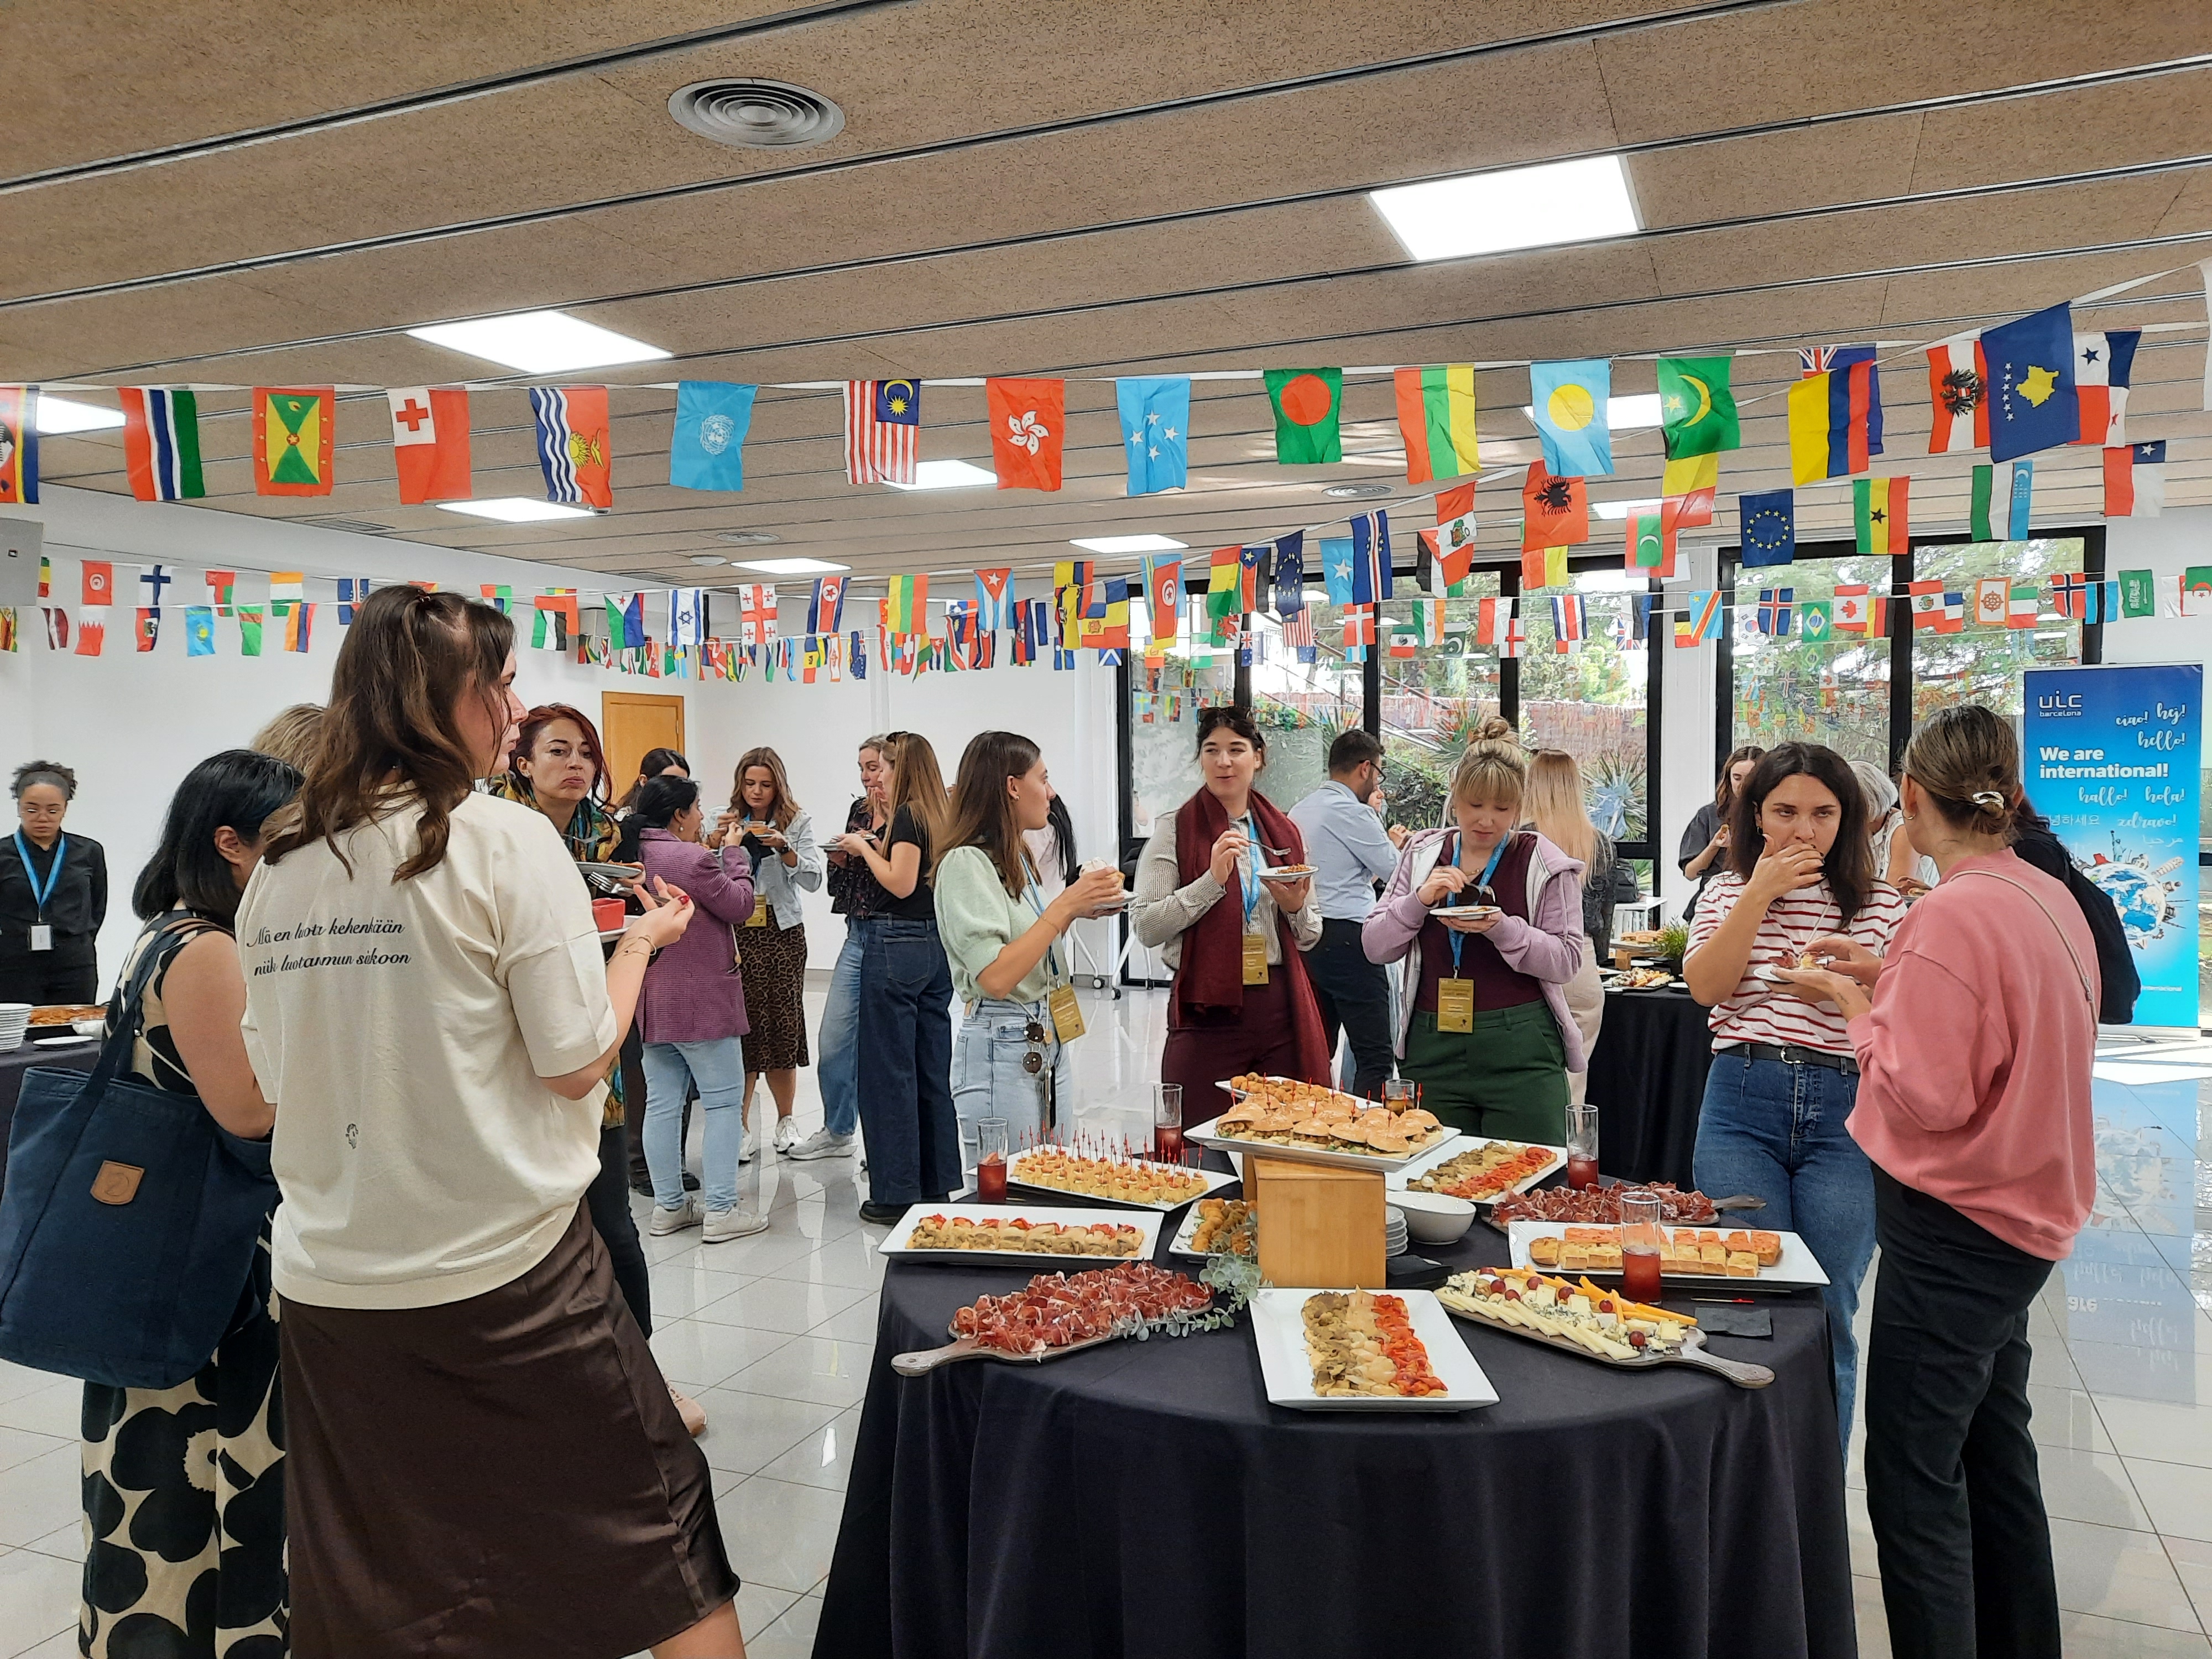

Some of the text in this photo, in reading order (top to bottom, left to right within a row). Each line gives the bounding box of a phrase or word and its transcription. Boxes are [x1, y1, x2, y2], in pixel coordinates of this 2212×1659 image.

[2116, 711, 2149, 726] ciao!
[2137, 730, 2185, 750] hello!
[2039, 747, 2104, 761] We are
[2039, 763, 2169, 779] international!
[2078, 786, 2128, 806] hallo!
[2145, 785, 2185, 806] hola!
[2037, 814, 2100, 826] 녕하세요
[2117, 811, 2177, 828] zdravo!
[274, 930, 291, 941] en
